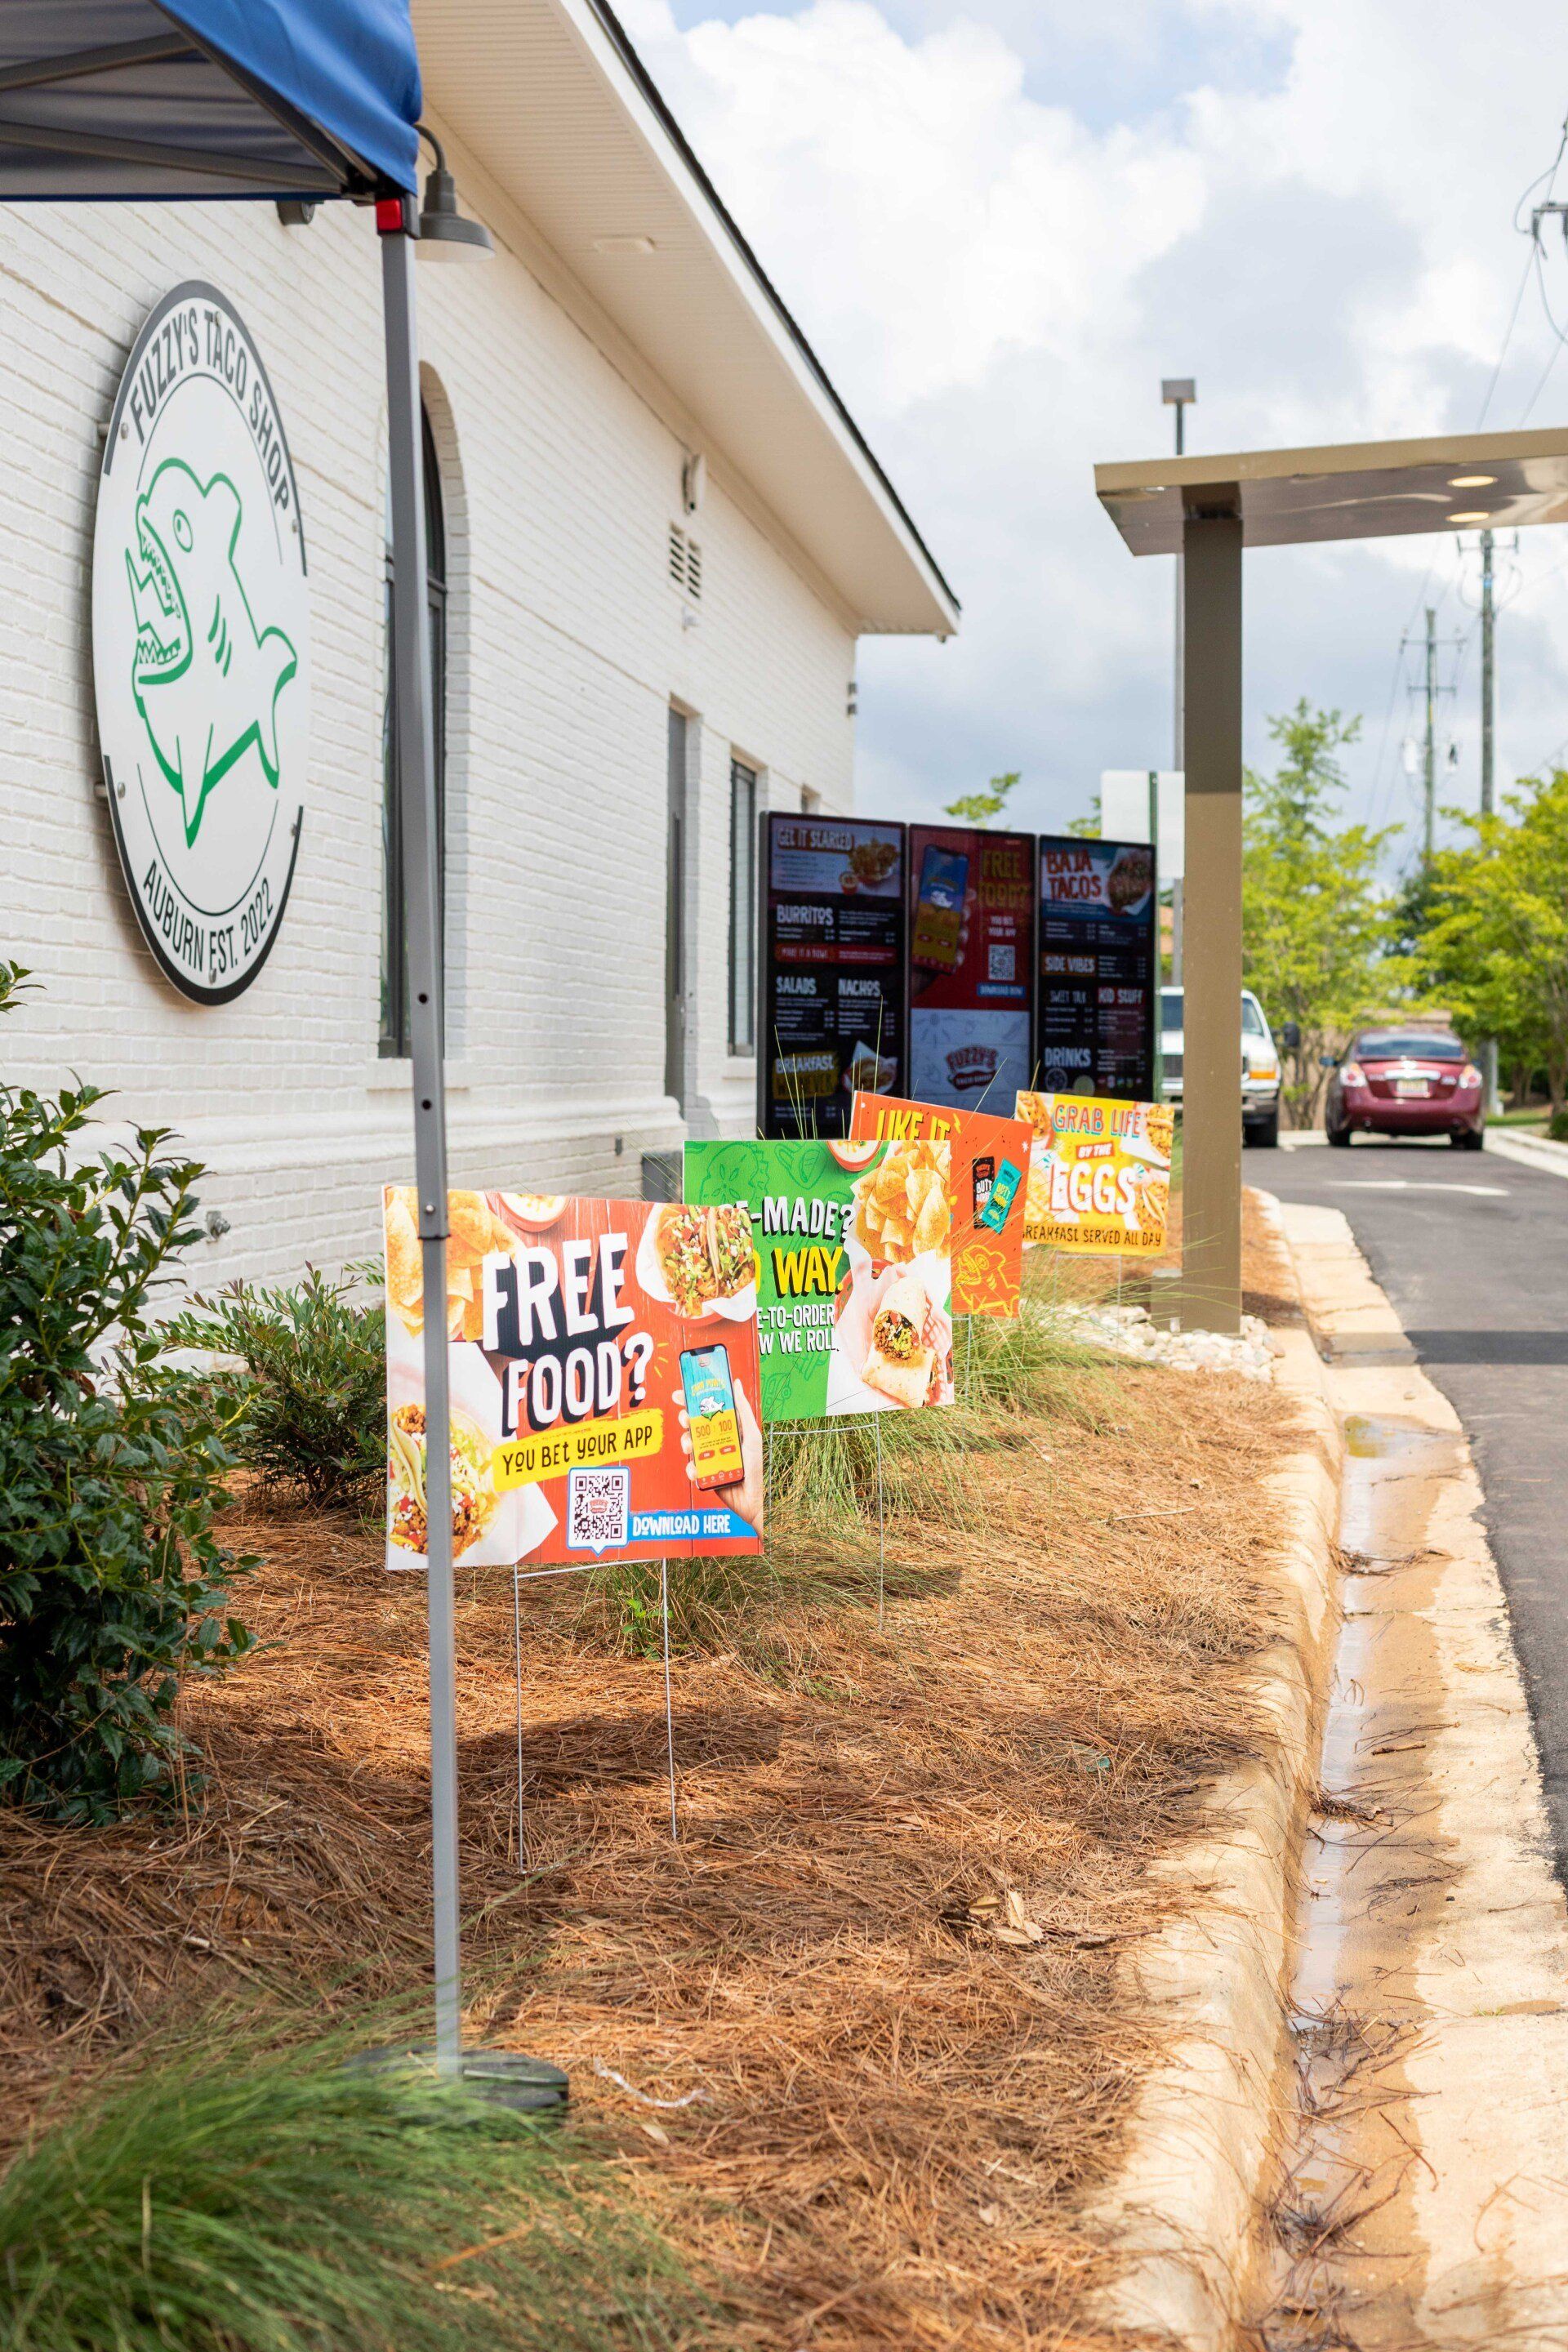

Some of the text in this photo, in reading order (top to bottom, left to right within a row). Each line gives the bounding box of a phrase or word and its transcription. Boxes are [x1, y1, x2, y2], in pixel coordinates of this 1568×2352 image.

[129, 307, 289, 510] FUZZY'S TACO SHOP
[1046, 849, 1093, 874] BAJA
[1048, 875, 1102, 900] TACOS
[142, 859, 274, 973] AUBURN EST. 2022
[777, 904, 834, 926] BURRITOS
[776, 975, 817, 995] SALADS
[838, 979, 881, 997] NACHOS
[1045, 1046, 1091, 1067] DRINKS
[929, 1116, 951, 1141] IT
[1053, 1104, 1142, 1138] GRAB LIFE
[1078, 1143, 1112, 1159] BY THE
[1049, 1161, 1137, 1214] EGGS
[1084, 1228, 1120, 1245] SERVED
[1125, 1232, 1138, 1245] ALL
[1143, 1232, 1161, 1246] DAY
[772, 1246, 844, 1297] WAY.
[482, 1232, 635, 1351] FREE
[779, 1330, 802, 1354] WE
[505, 1332, 653, 1432] FOOD?
[695, 1419, 733, 1438] 500 100
[502, 1425, 653, 1476] YOU BET YOUR APP
[632, 1514, 731, 1537] DOWNLOAD HERE
